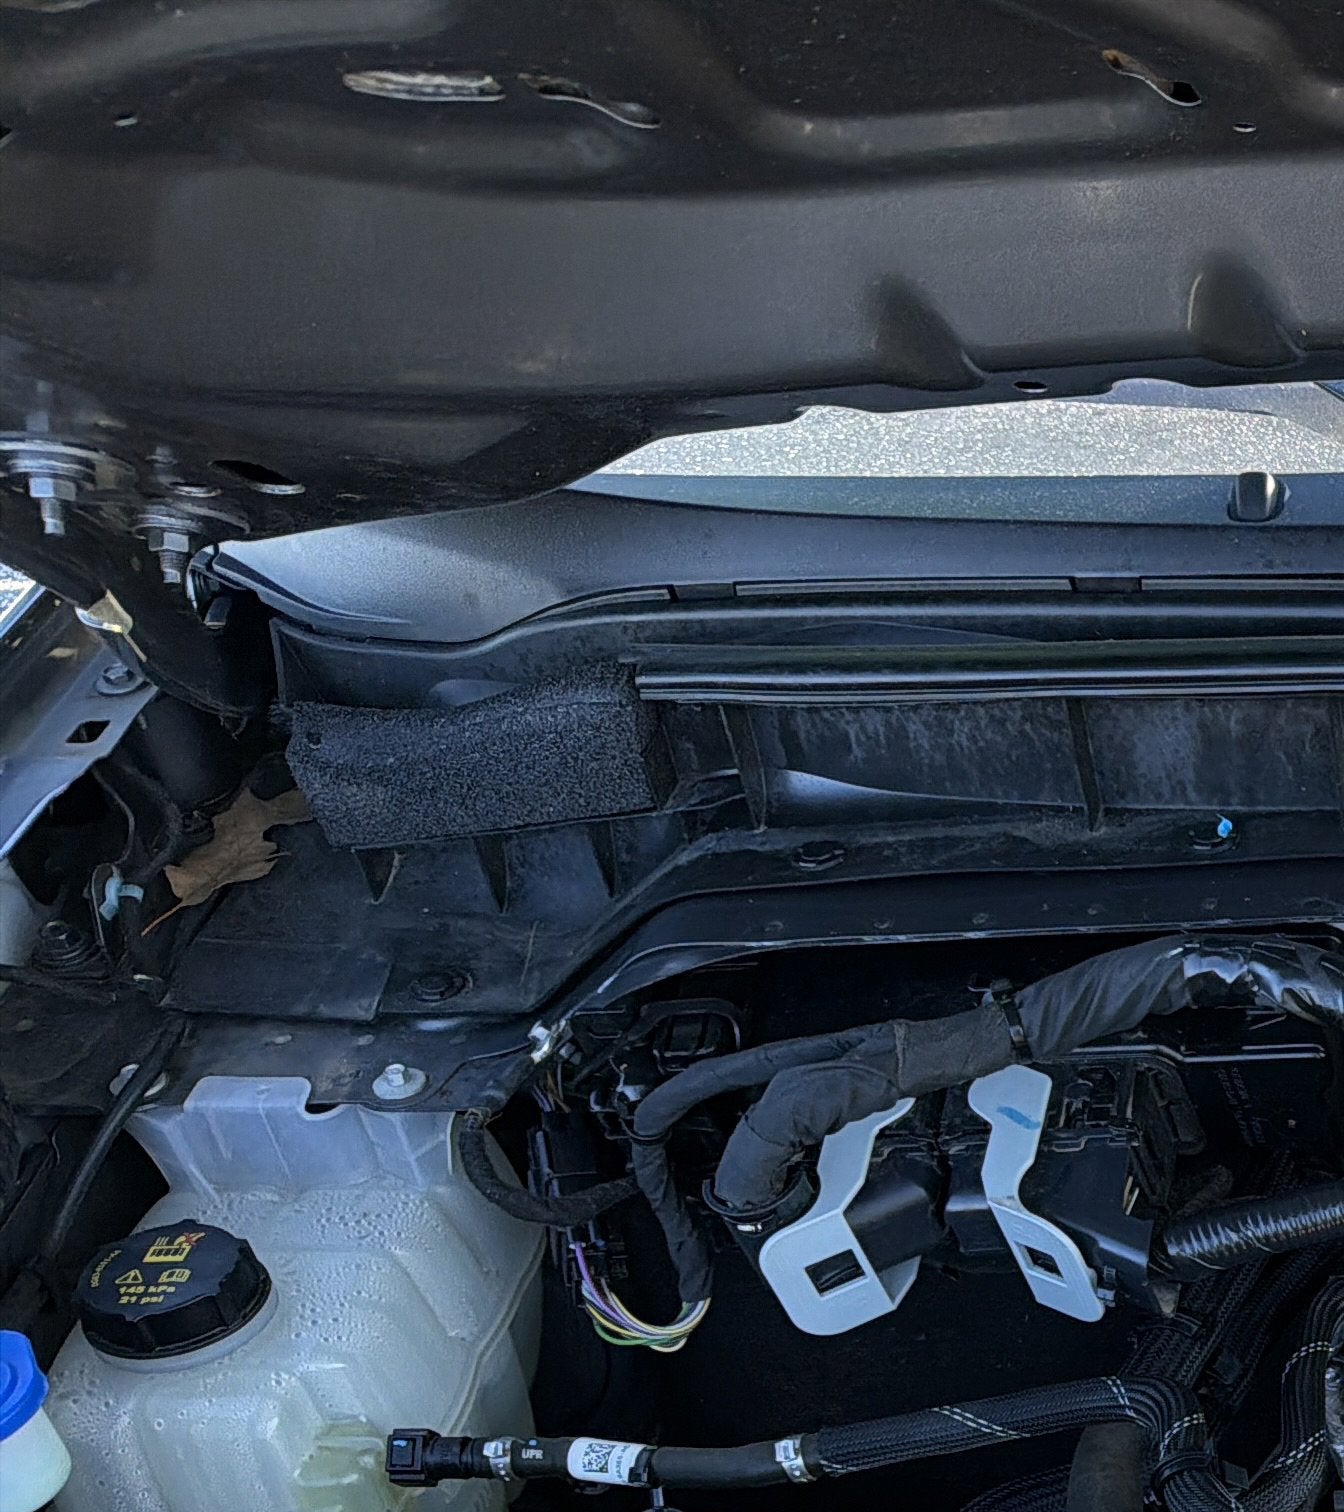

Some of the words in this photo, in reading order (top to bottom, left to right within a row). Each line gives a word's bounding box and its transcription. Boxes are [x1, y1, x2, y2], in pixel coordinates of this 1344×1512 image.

[118, 1285, 146, 1295] 145
[147, 1285, 176, 1294] kPa
[118, 1296, 140, 1305] 21
[141, 1295, 165, 1305] psi
[521, 1448, 544, 1460] UPR
